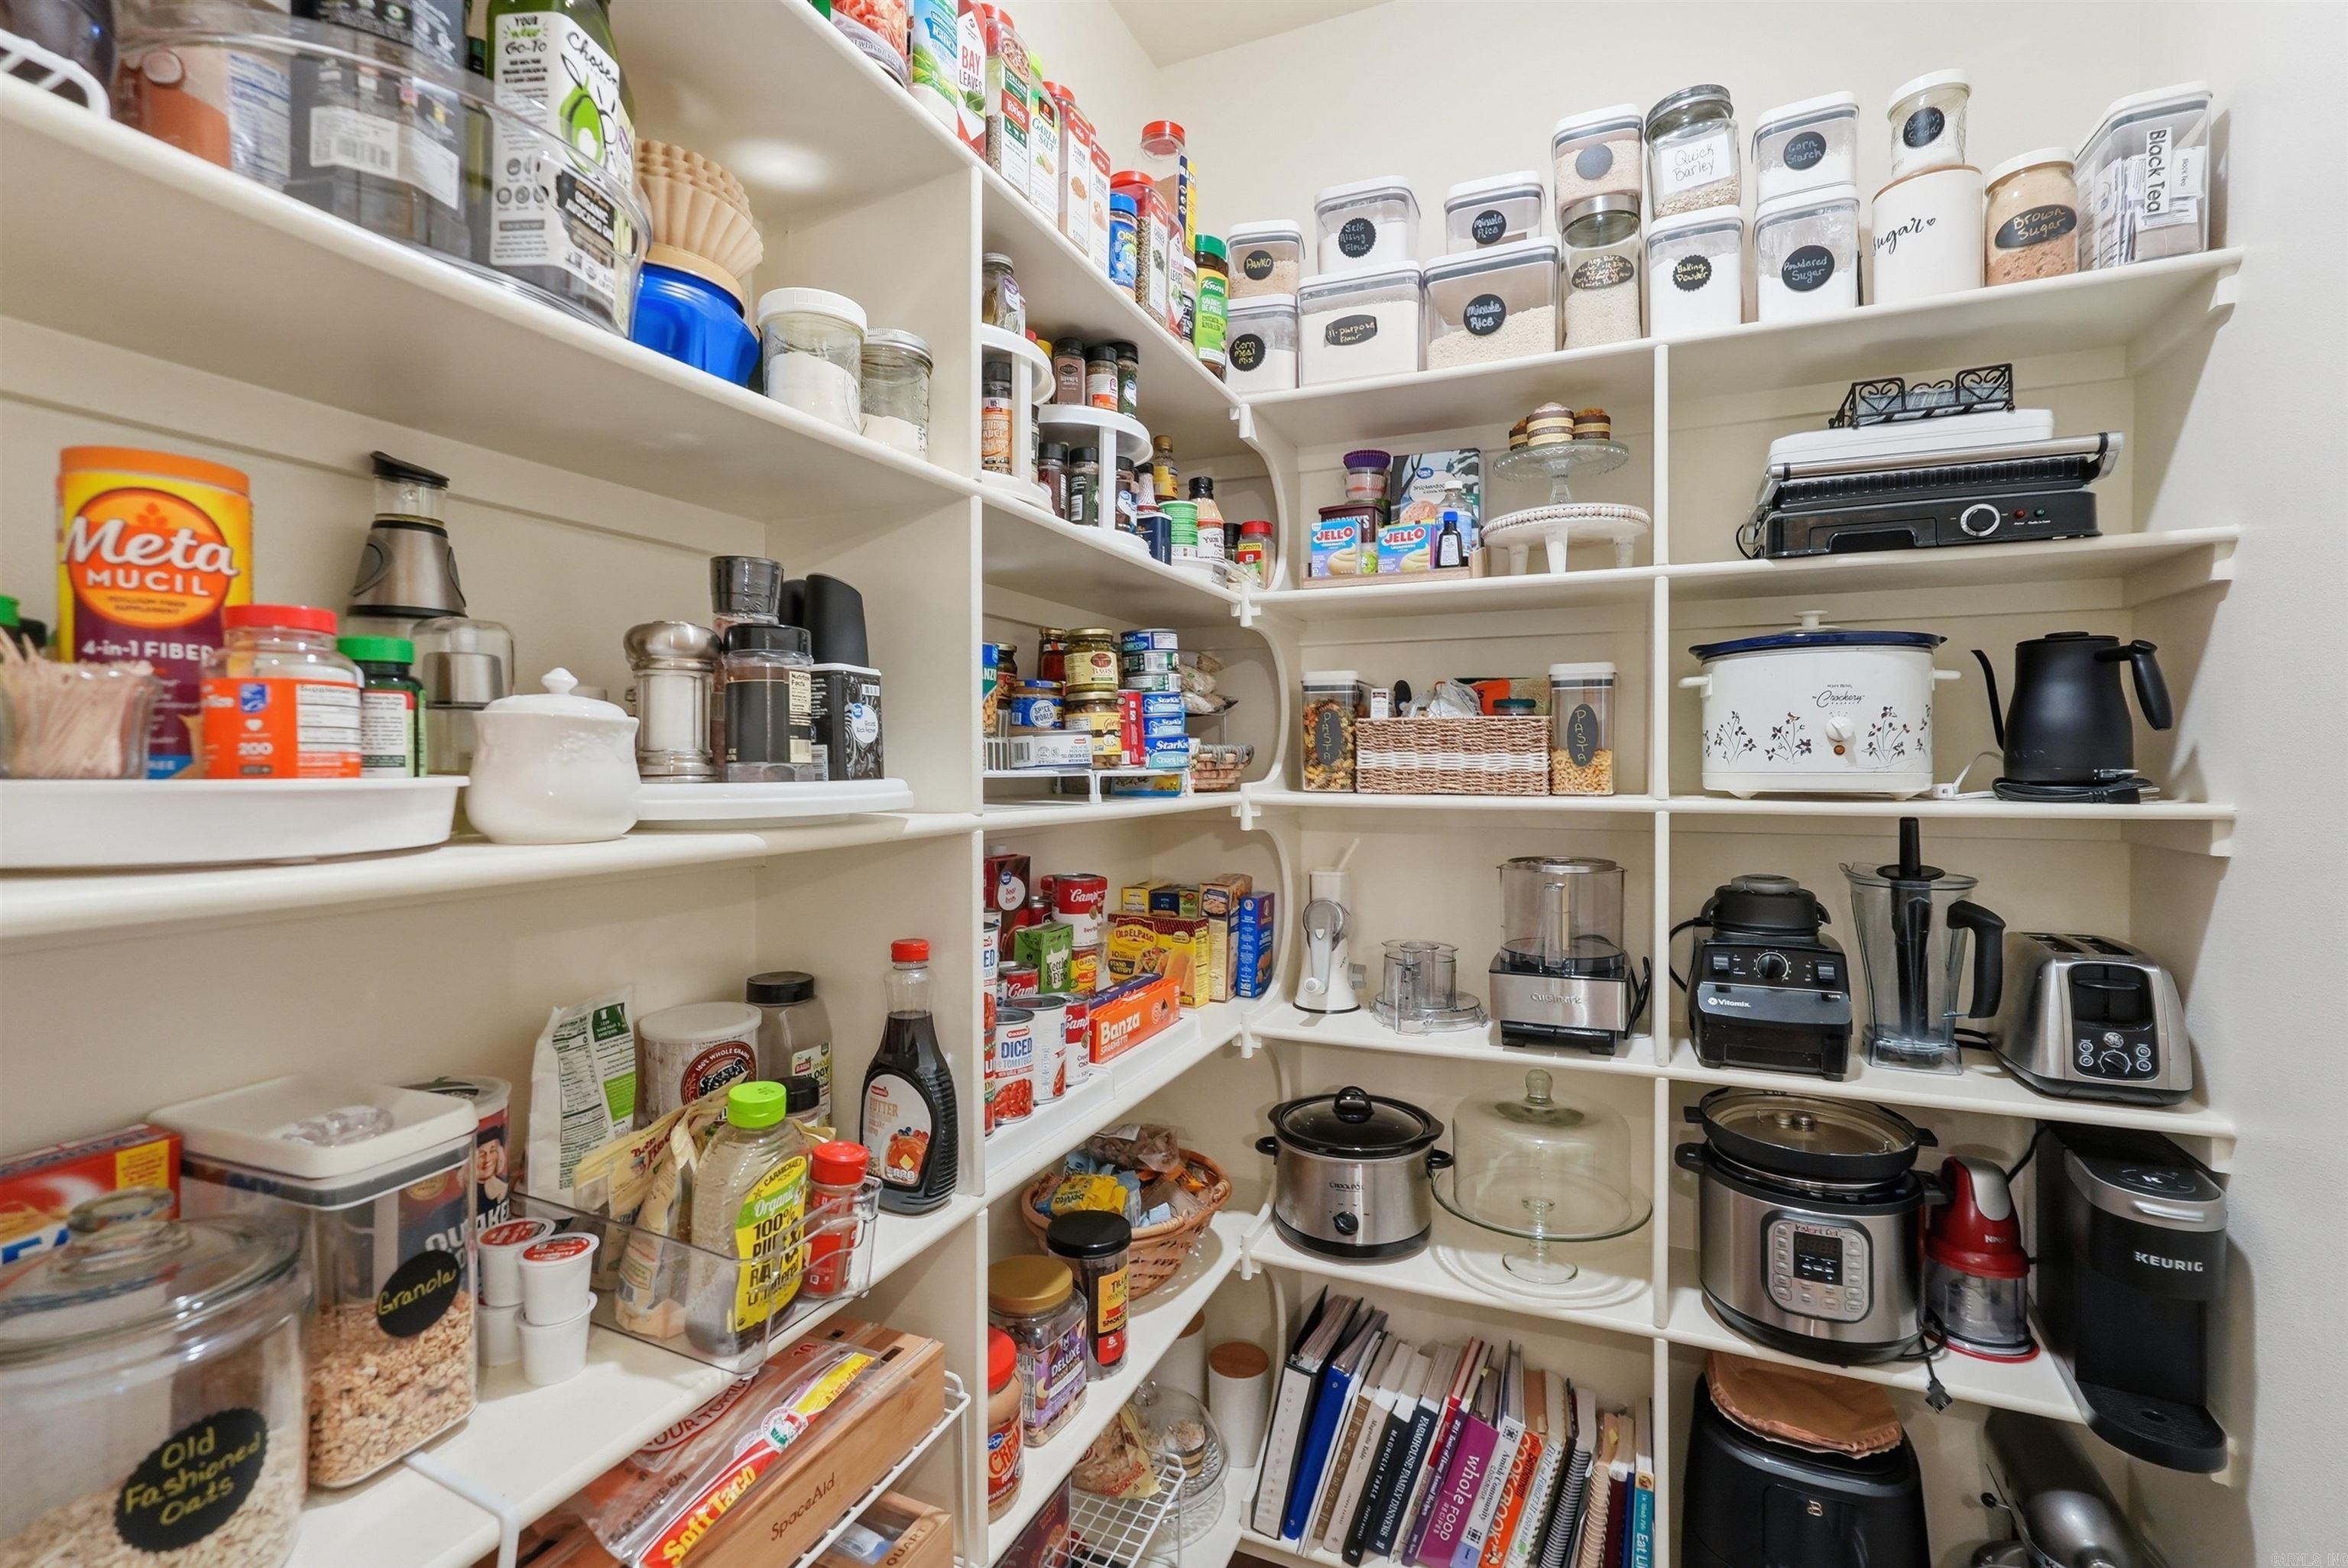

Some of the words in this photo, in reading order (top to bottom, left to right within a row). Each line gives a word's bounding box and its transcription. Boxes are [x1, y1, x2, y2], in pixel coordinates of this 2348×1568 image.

[962, 46, 981, 76] BAY
[959, 69, 983, 94] LEAVES
[1675, 143, 1714, 166] Quick
[1786, 148, 1822, 165] Starch
[1787, 139, 1818, 153] Corn
[2148, 129, 2167, 177] Black
[1672, 158, 1714, 181] Barley
[2146, 182, 2165, 212] Tea
[1477, 225, 1499, 238] Rice
[2013, 207, 2067, 230] Brown
[2018, 217, 2066, 241] Sugar
[1675, 271, 1707, 282] Powder
[1783, 256, 1827, 271] Powdered
[1792, 268, 1825, 287] Sugar
[1467, 300, 1501, 316] Minute
[1470, 316, 1495, 329] Rice
[62, 516, 240, 576] Meta
[86, 569, 210, 596] MUCIL
[81, 639, 139, 657] 4-in-1
[1034, 713, 1054, 721] WORLD
[1322, 711, 1332, 761] PASTA
[1574, 709, 1588, 763] PASTA
[1046, 959, 1069, 976] Kettle
[1053, 971, 1069, 984] Fire
[1717, 999, 1751, 1008] Vitamix
[1100, 1011, 1141, 1045] Banza
[709, 1048, 732, 1060] WHOLE
[1000, 1037, 1033, 1059] DICED
[752, 1206, 795, 1241] 100%
[2133, 1251, 2204, 1273] KEURIG
[379, 1268, 456, 1315] Granola
[1051, 1342, 1081, 1377] DELUXE
[161, 1426, 215, 1470] Old
[1378, 1429, 1399, 1473] MAGNOLIA
[1402, 1415, 1429, 1469] FARMHOUSE
[125, 1430, 261, 1514] Fashioned
[1391, 1467, 1411, 1499] FAMILY
[1453, 1455, 1480, 1505] whole
[1370, 1473, 1383, 1500] TABLE
[160, 1476, 235, 1525] Oats
[770, 1472, 835, 1540] SpaceAid
[662, 1502, 715, 1568] Soft
[712, 1463, 757, 1522] Taco
[1379, 1498, 1399, 1537] DINNERS
[1440, 1505, 1461, 1542] FOOD
[1636, 1531, 1649, 1556] Eat
